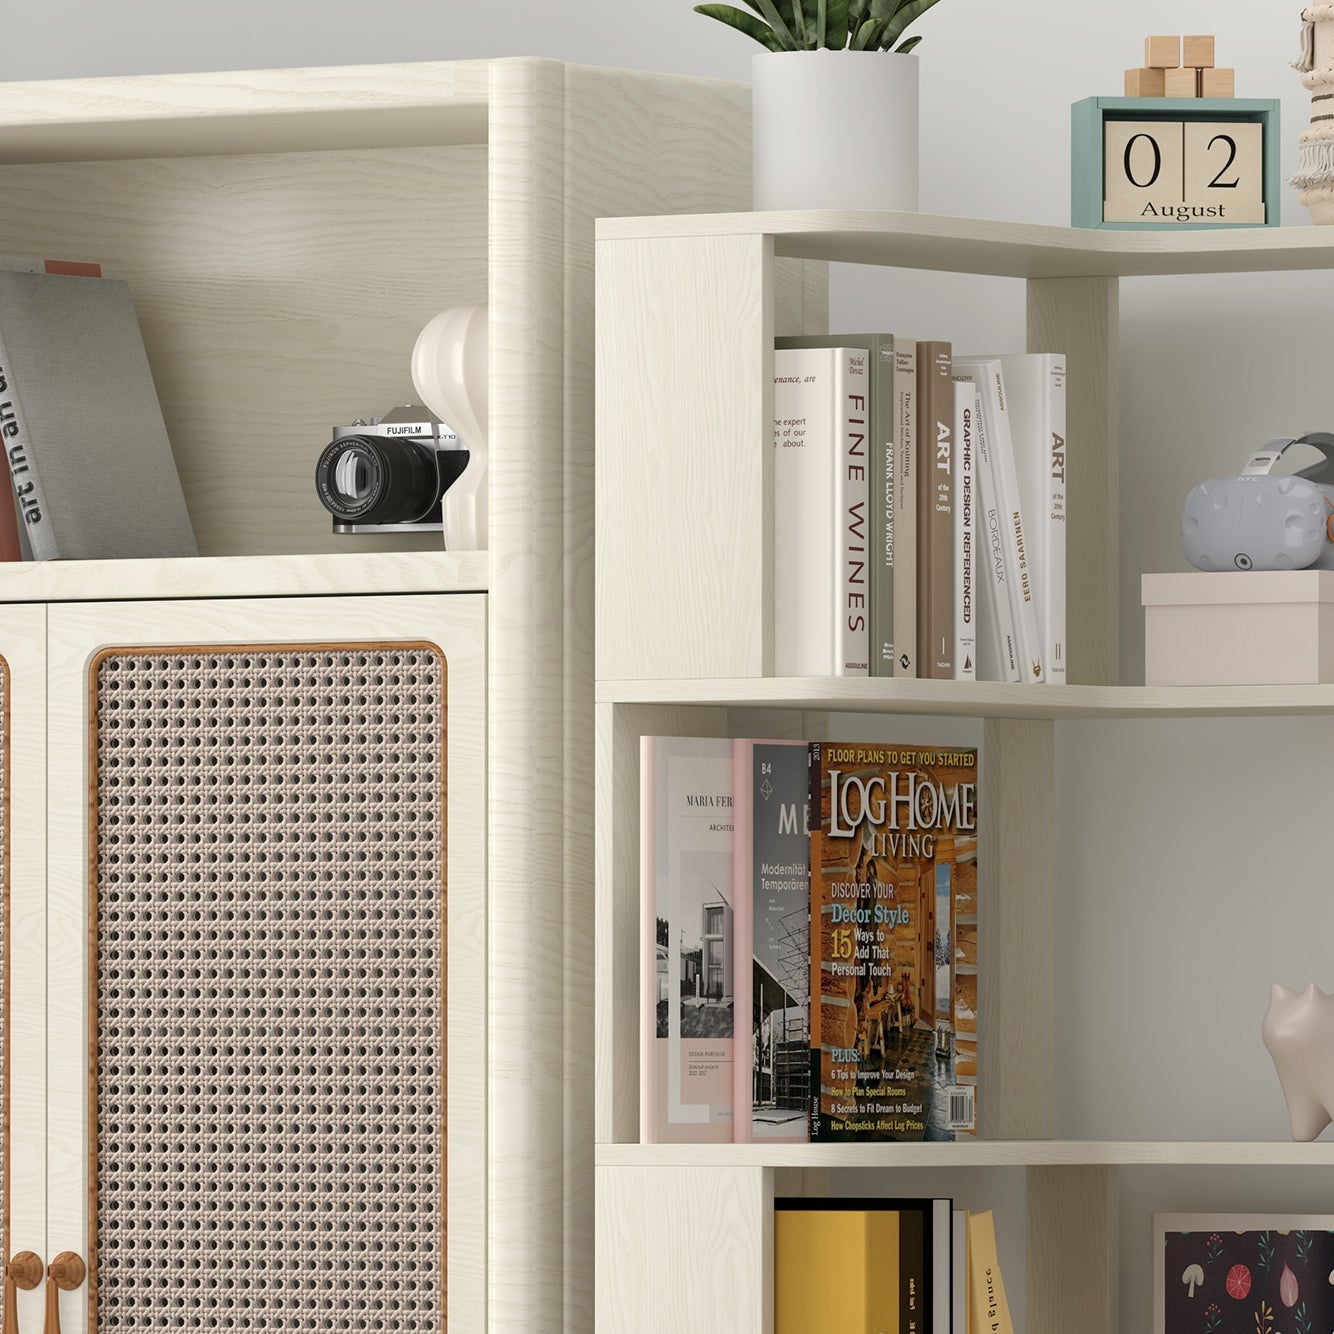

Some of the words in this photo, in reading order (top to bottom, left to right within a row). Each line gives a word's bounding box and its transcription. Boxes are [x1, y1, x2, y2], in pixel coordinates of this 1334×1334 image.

[1124, 134, 1161, 187] 0
[1207, 135, 1240, 188] 2
[1140, 201, 1226, 222] August
[783, 418, 806, 427] expert
[783, 428, 790, 436] of
[848, 395, 864, 481] FINE
[937, 421, 951, 475] ART
[963, 408, 972, 471] GRAPHIC
[9, 444, 29, 475] in
[1052, 432, 1065, 484] ART
[18, 481, 42, 525] art
[963, 476, 972, 527] DESIGN
[988, 509, 1005, 585] BORDEAUX
[1013, 511, 1027, 569] SAARINEN
[848, 501, 864, 632] WINES
[963, 532, 972, 624] REFERENCED
[1022, 573, 1031, 602] EERO
[828, 749, 855, 763] FLOOR
[857, 750, 885, 764] PLANS
[887, 751, 898, 764] TO
[900, 751, 916, 765] GET
[919, 752, 936, 766] YOU
[938, 752, 975, 767] STARTED
[687, 795, 714, 807] MARIA
[872, 833, 934, 859] LIVING
[761, 863, 806, 875] Modernität
[831, 882, 870, 898] DISCOVER
[873, 883, 894, 898] YOUR
[831, 903, 871, 923] Decor
[874, 904, 909, 929] Style
[831, 929, 852, 959] 15
[854, 928, 874, 943] Ways
[877, 929, 885, 941] to
[854, 945, 869, 959] Add
[872, 946, 889, 959] That
[831, 962, 866, 976] Personal
[868, 963, 891, 976] Touch
[831, 1048, 860, 1063] PLUS:
[831, 1071, 836, 1079] 6
[838, 1070, 849, 1081] Tips
[850, 1071, 857, 1080] to
[858, 1070, 880, 1081] Improve
[881, 1070, 894, 1080] Your
[895, 1070, 915, 1082] Design
[831, 1087, 844, 1097] How
[845, 1088, 852, 1096] to
[853, 1087, 864, 1097] Plan
[866, 1087, 886, 1098] Special
[887, 1087, 906, 1097] Rooms
[831, 1104, 836, 1113] 8
[837, 1103, 858, 1114] Secrets
[860, 1104, 866, 1114] to
[867, 1103, 875, 1114] Fit
[876, 1104, 894, 1114] Dream
[896, 1104, 901, 1114] to
[902, 1103, 923, 1115] Budget
[811, 1119, 821, 1136] Log
[831, 1120, 844, 1130] How
[845, 1120, 875, 1132] Chopsticks
[876, 1120, 893, 1130] Affect
[895, 1120, 905, 1132] Log
[906, 1120, 924, 1130] Prices
